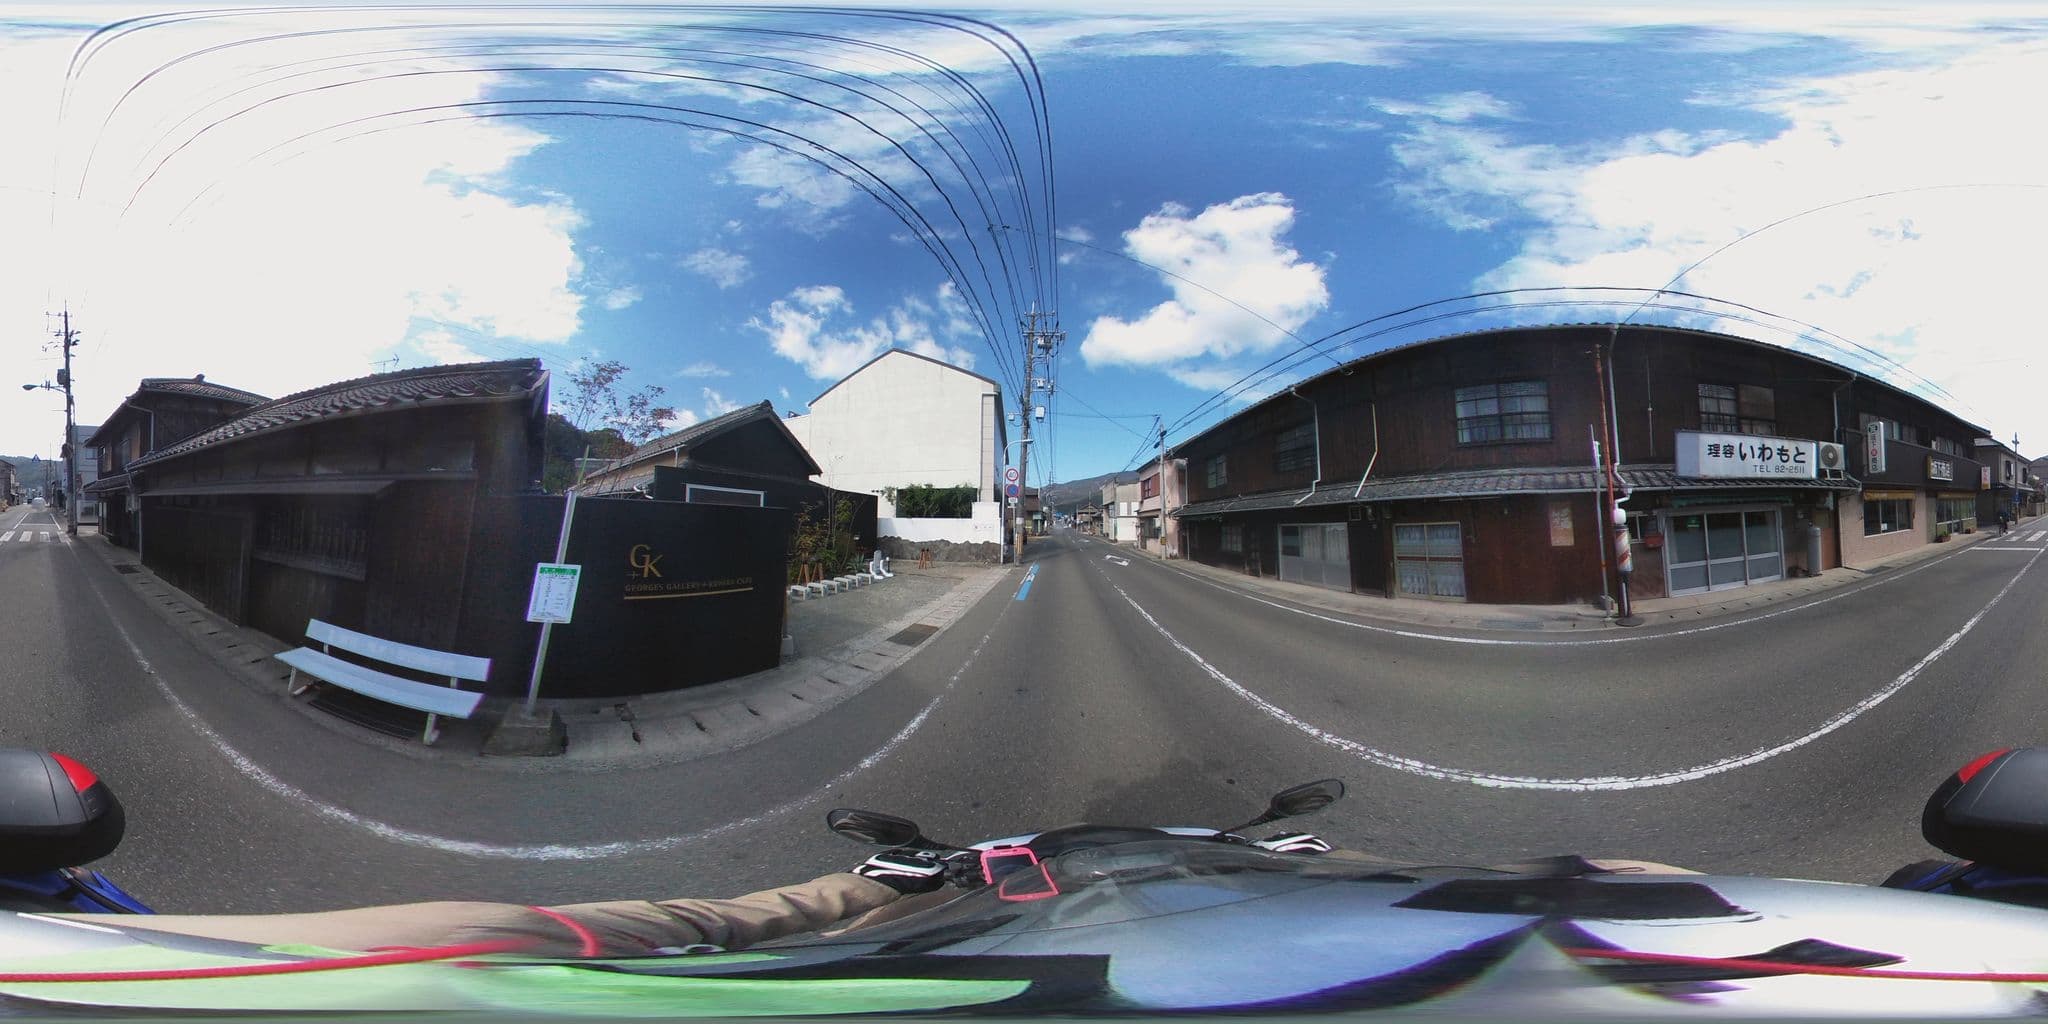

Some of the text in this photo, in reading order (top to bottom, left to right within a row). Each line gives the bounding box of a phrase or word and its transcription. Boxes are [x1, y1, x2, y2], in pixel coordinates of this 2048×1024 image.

[1707, 442, 1806, 464] 理容いわもと
[1753, 465, 1805, 474] TEL 82-2511
